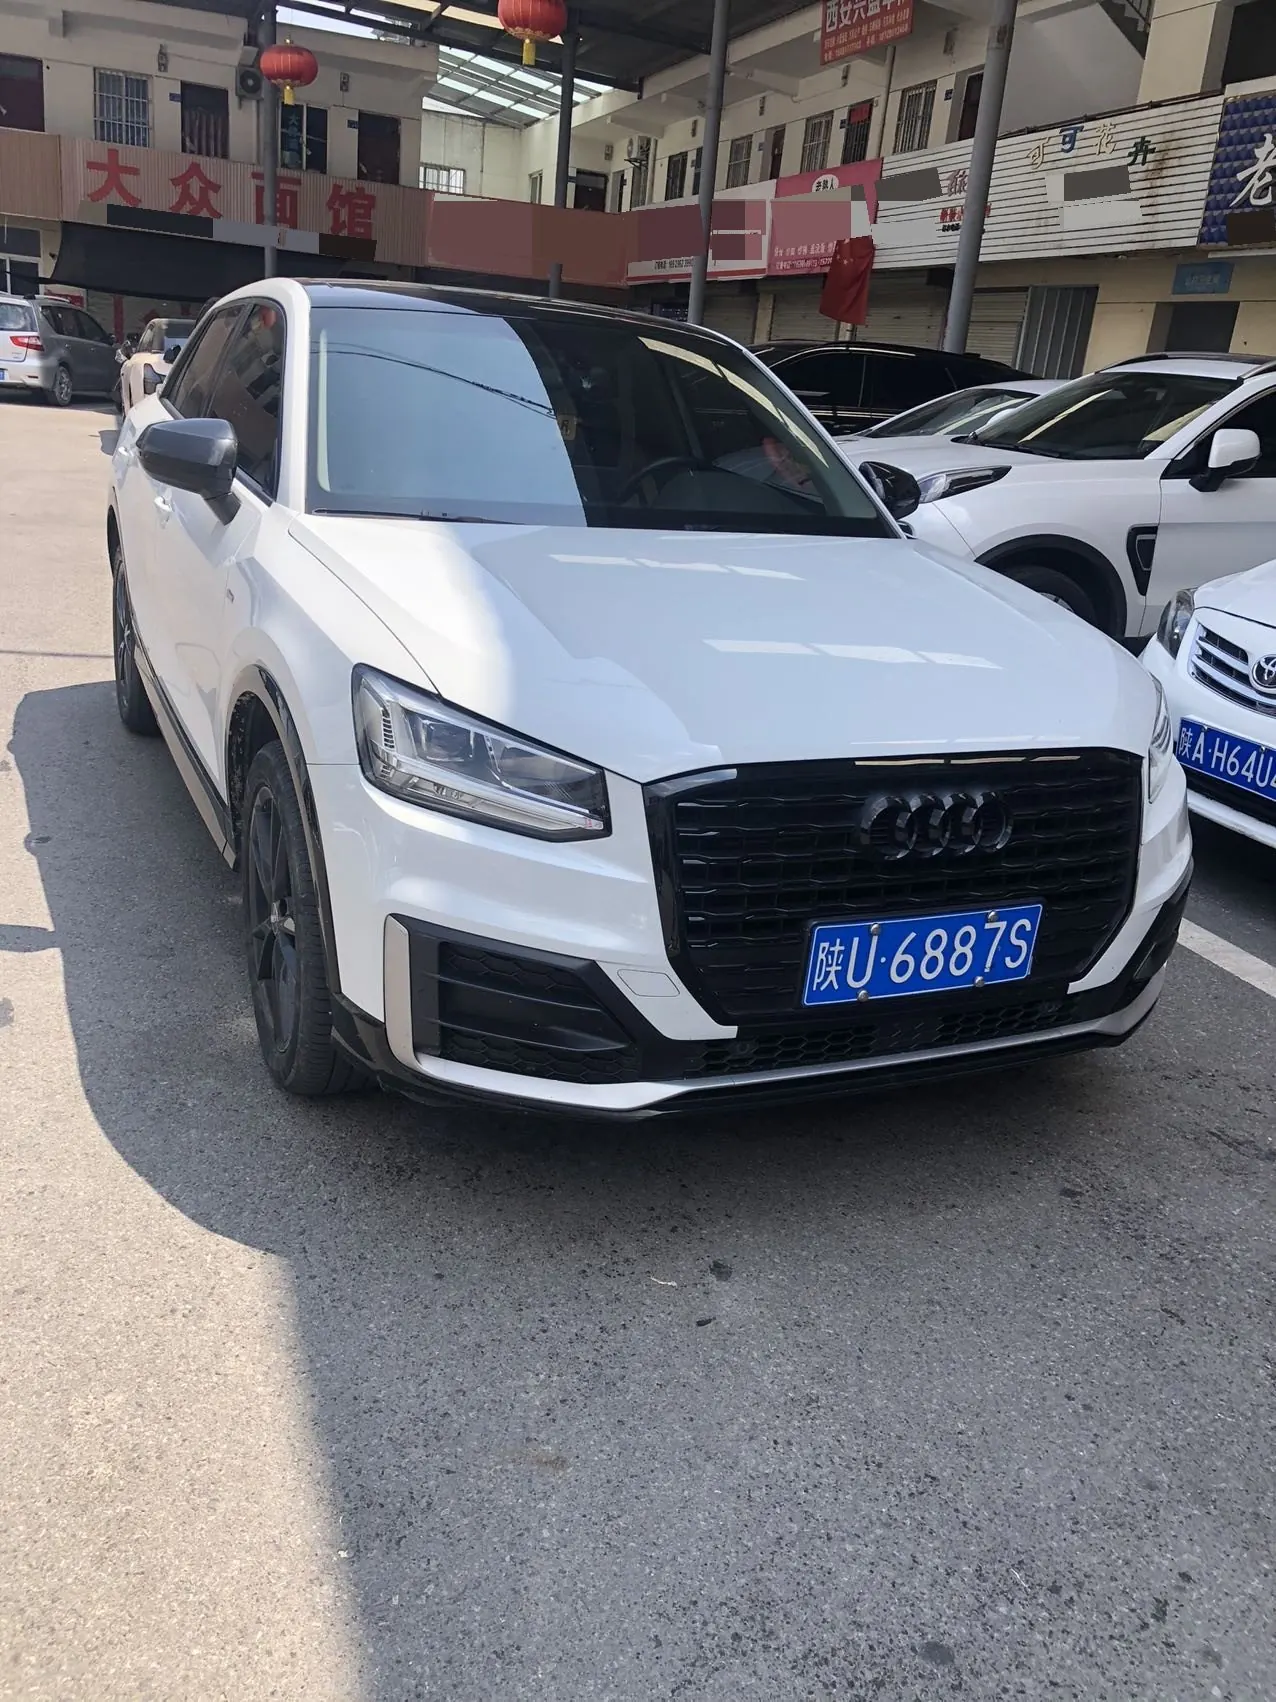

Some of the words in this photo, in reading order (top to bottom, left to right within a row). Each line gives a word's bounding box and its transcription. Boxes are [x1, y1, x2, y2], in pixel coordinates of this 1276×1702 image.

[1026, 122, 1157, 170] 可可花卉
[86, 148, 378, 239] 大众面馆
[1178, 727, 1276, 788] 陕A·H64U
[812, 918, 1032, 992] 陕U·6887S
